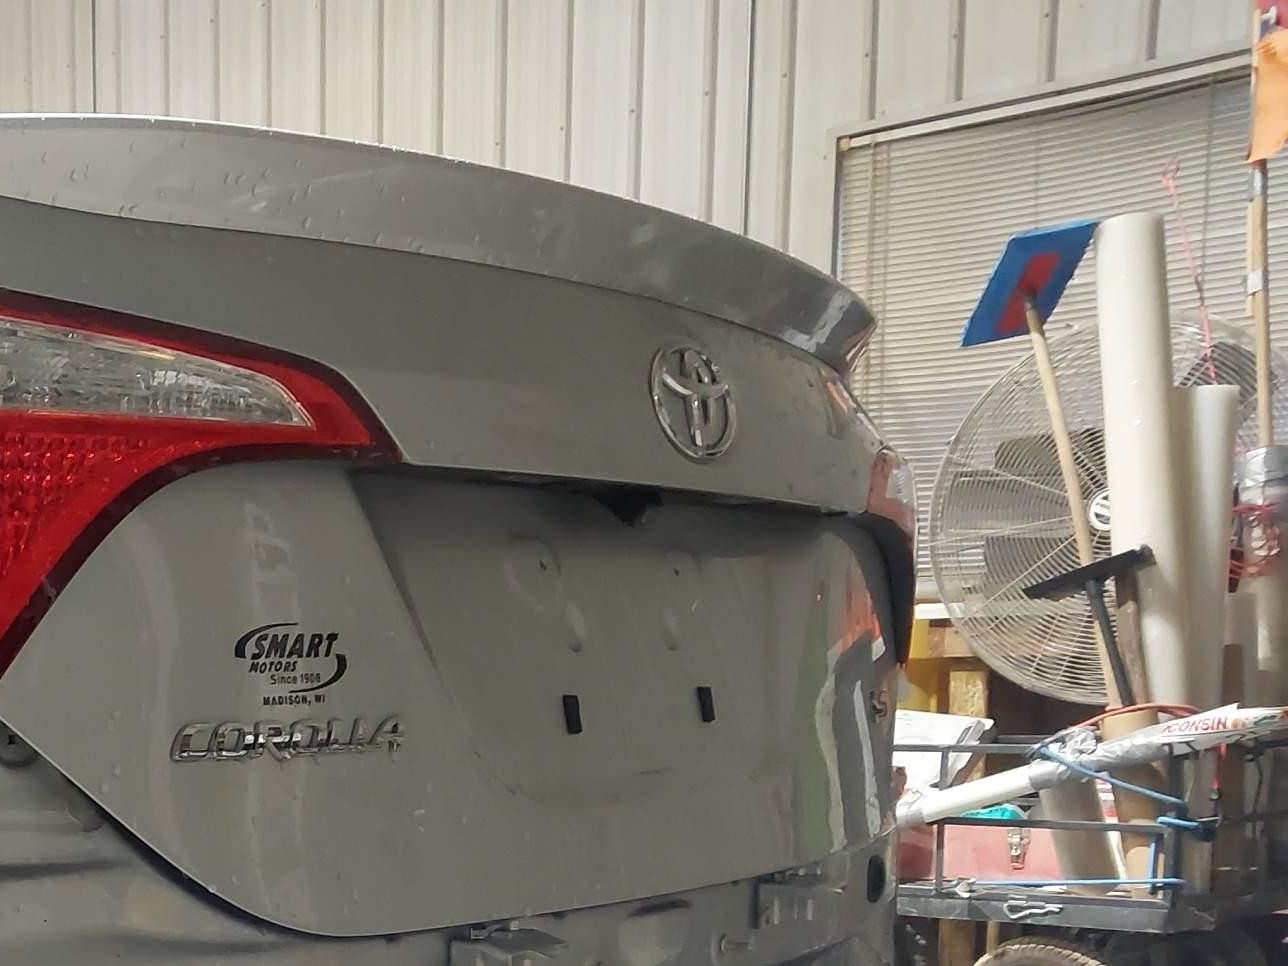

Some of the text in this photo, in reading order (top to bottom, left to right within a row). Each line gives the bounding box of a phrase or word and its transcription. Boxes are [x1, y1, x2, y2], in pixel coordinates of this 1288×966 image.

[251, 633, 339, 660] SMART
[249, 660, 298, 674] MOTORS
[270, 674, 298, 685] Since
[263, 694, 326, 706] MADISON, WI
[169, 714, 405, 762] COROLLA
